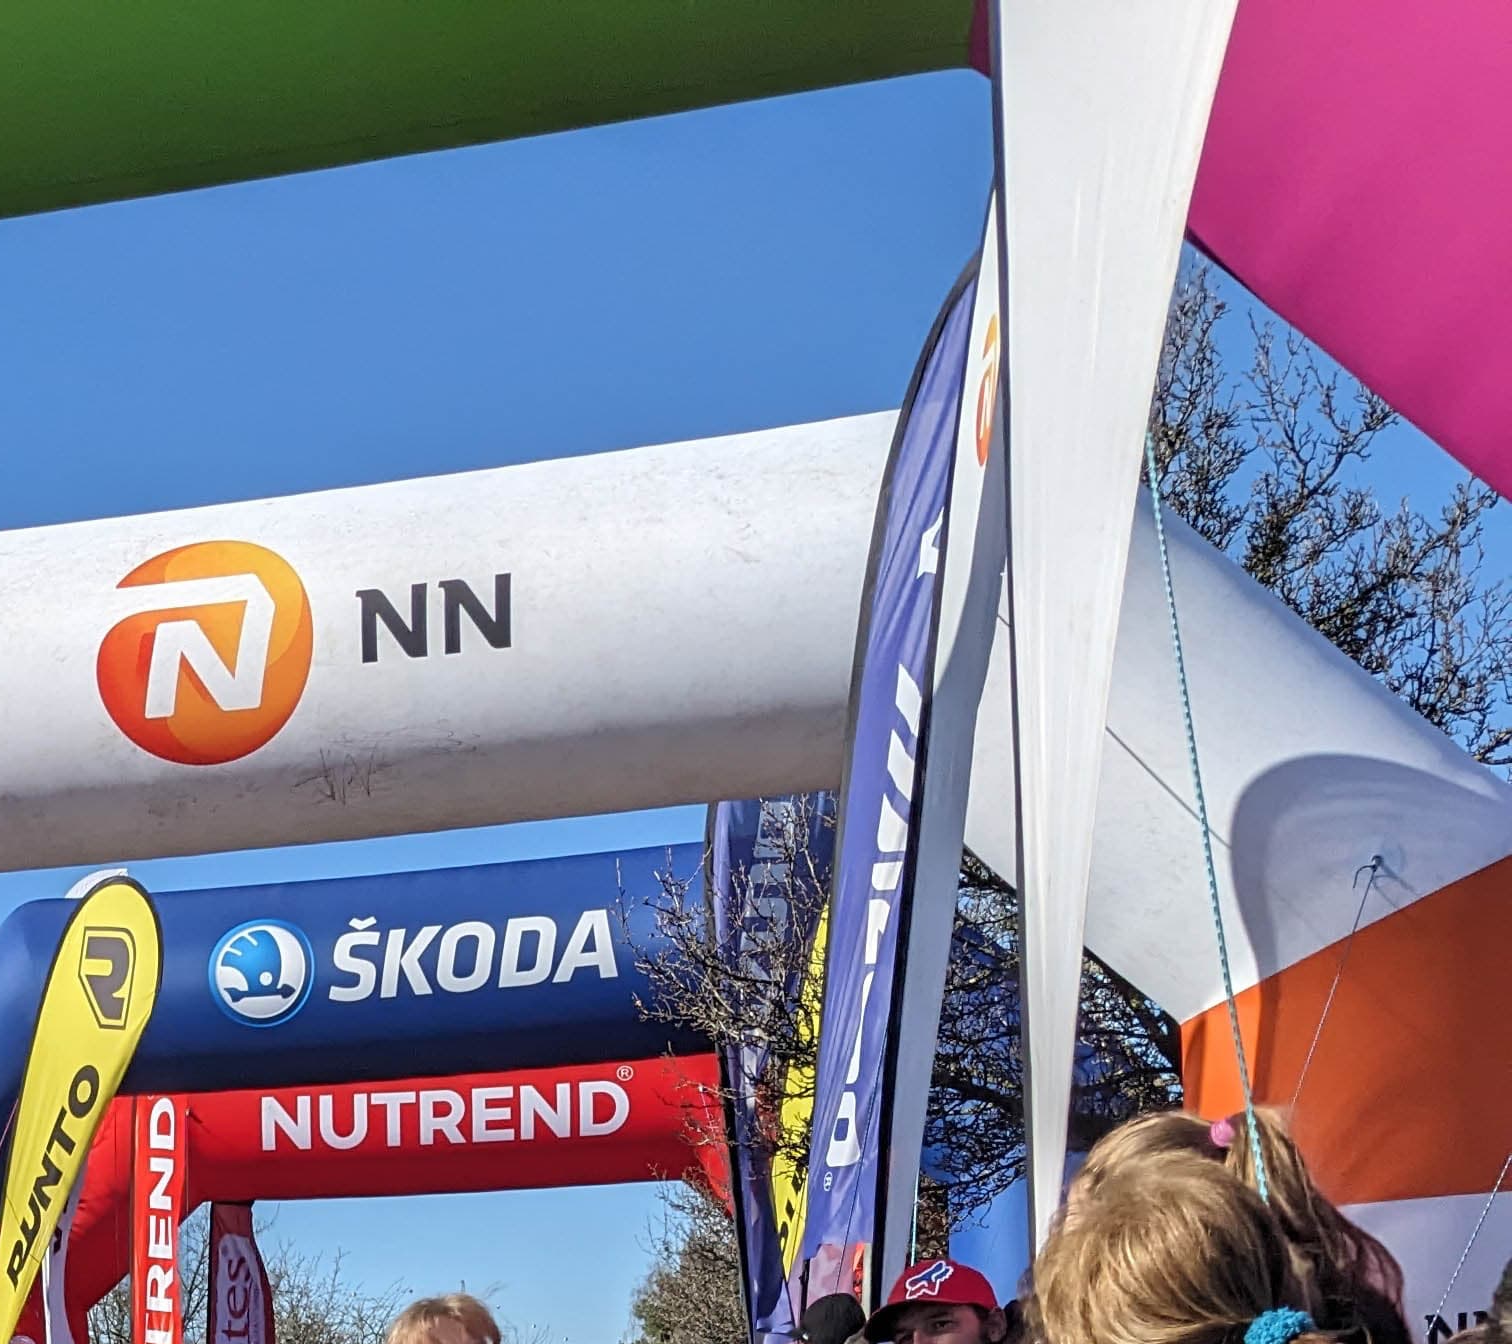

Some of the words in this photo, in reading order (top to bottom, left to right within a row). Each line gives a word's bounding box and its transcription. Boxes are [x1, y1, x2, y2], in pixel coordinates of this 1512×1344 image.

[356, 573, 512, 664] NN
[329, 909, 619, 1002] ŠKODA
[261, 1080, 631, 1151] NUTREND
[7, 1065, 99, 1290] RUNTO
